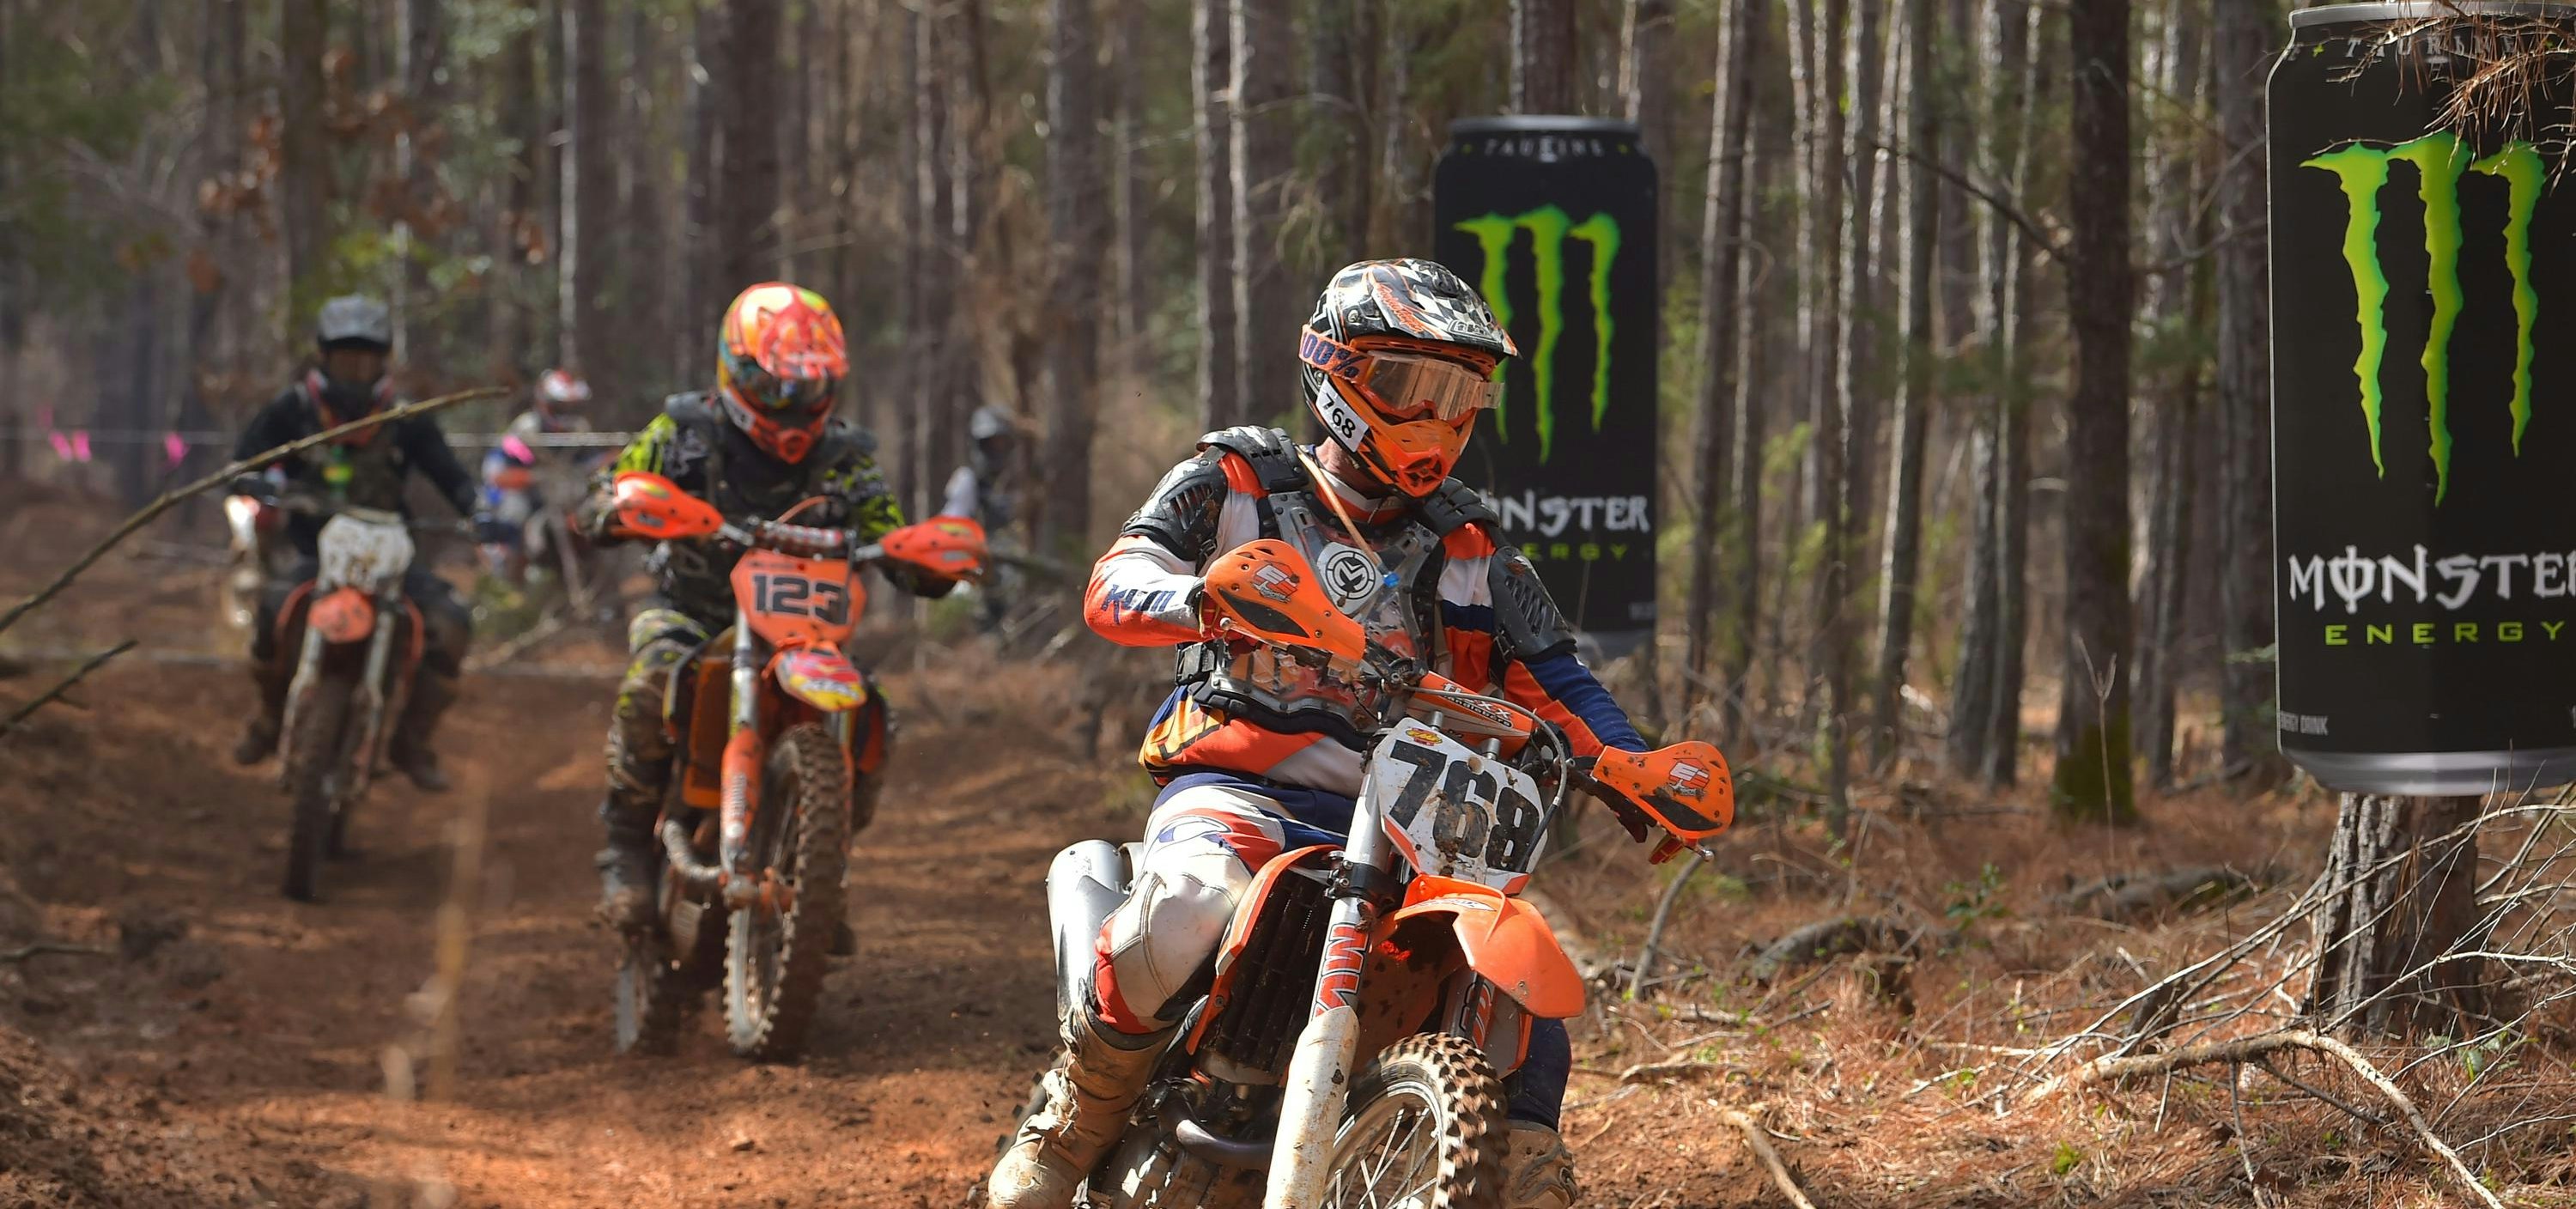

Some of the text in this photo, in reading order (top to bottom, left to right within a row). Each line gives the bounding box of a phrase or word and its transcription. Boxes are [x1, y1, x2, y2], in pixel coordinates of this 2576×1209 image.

[1302, 332, 1368, 379] 00%
[1322, 392, 1356, 439] 768
[1479, 489, 1650, 538] NSTER
[1522, 543, 1628, 560] ERGY
[752, 574, 850, 626] 123
[2324, 622, 2565, 646] ENERGY
[1388, 739, 1541, 873] 768
